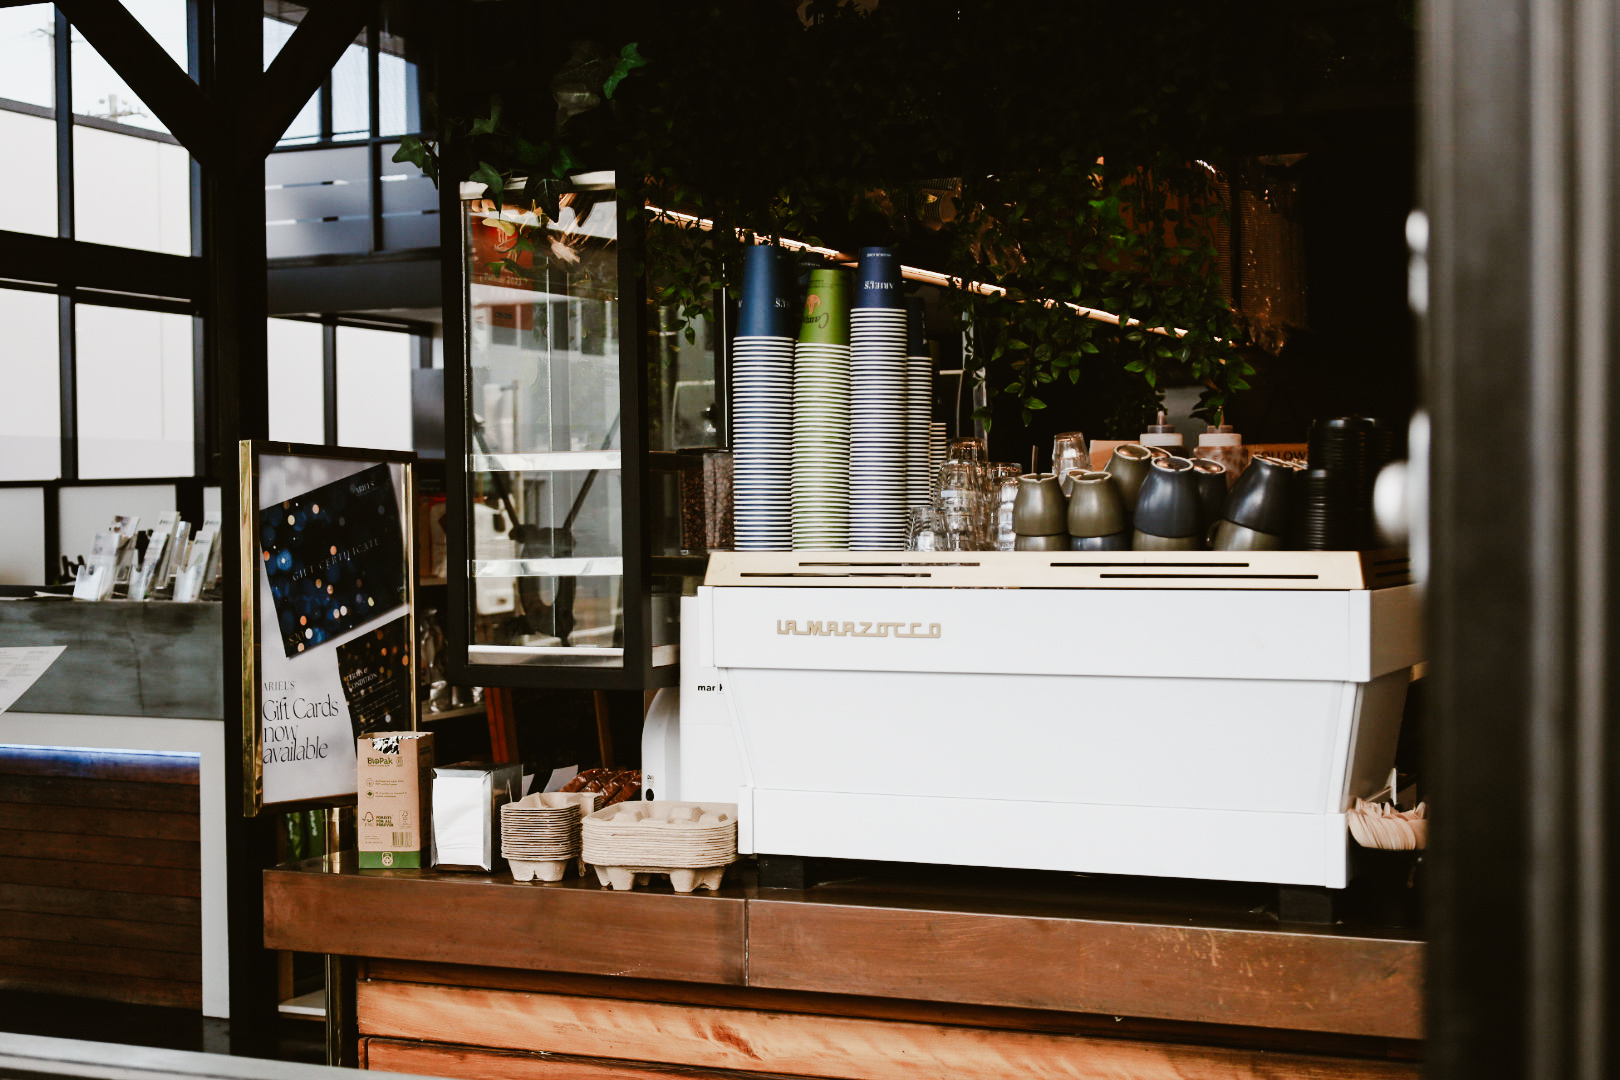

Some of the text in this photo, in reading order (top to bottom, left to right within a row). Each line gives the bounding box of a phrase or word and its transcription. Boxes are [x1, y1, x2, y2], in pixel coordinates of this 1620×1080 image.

[262, 697, 290, 722] Gift
[293, 694, 339, 720] Cards
[263, 725, 299, 744] now
[262, 736, 329, 765] available
